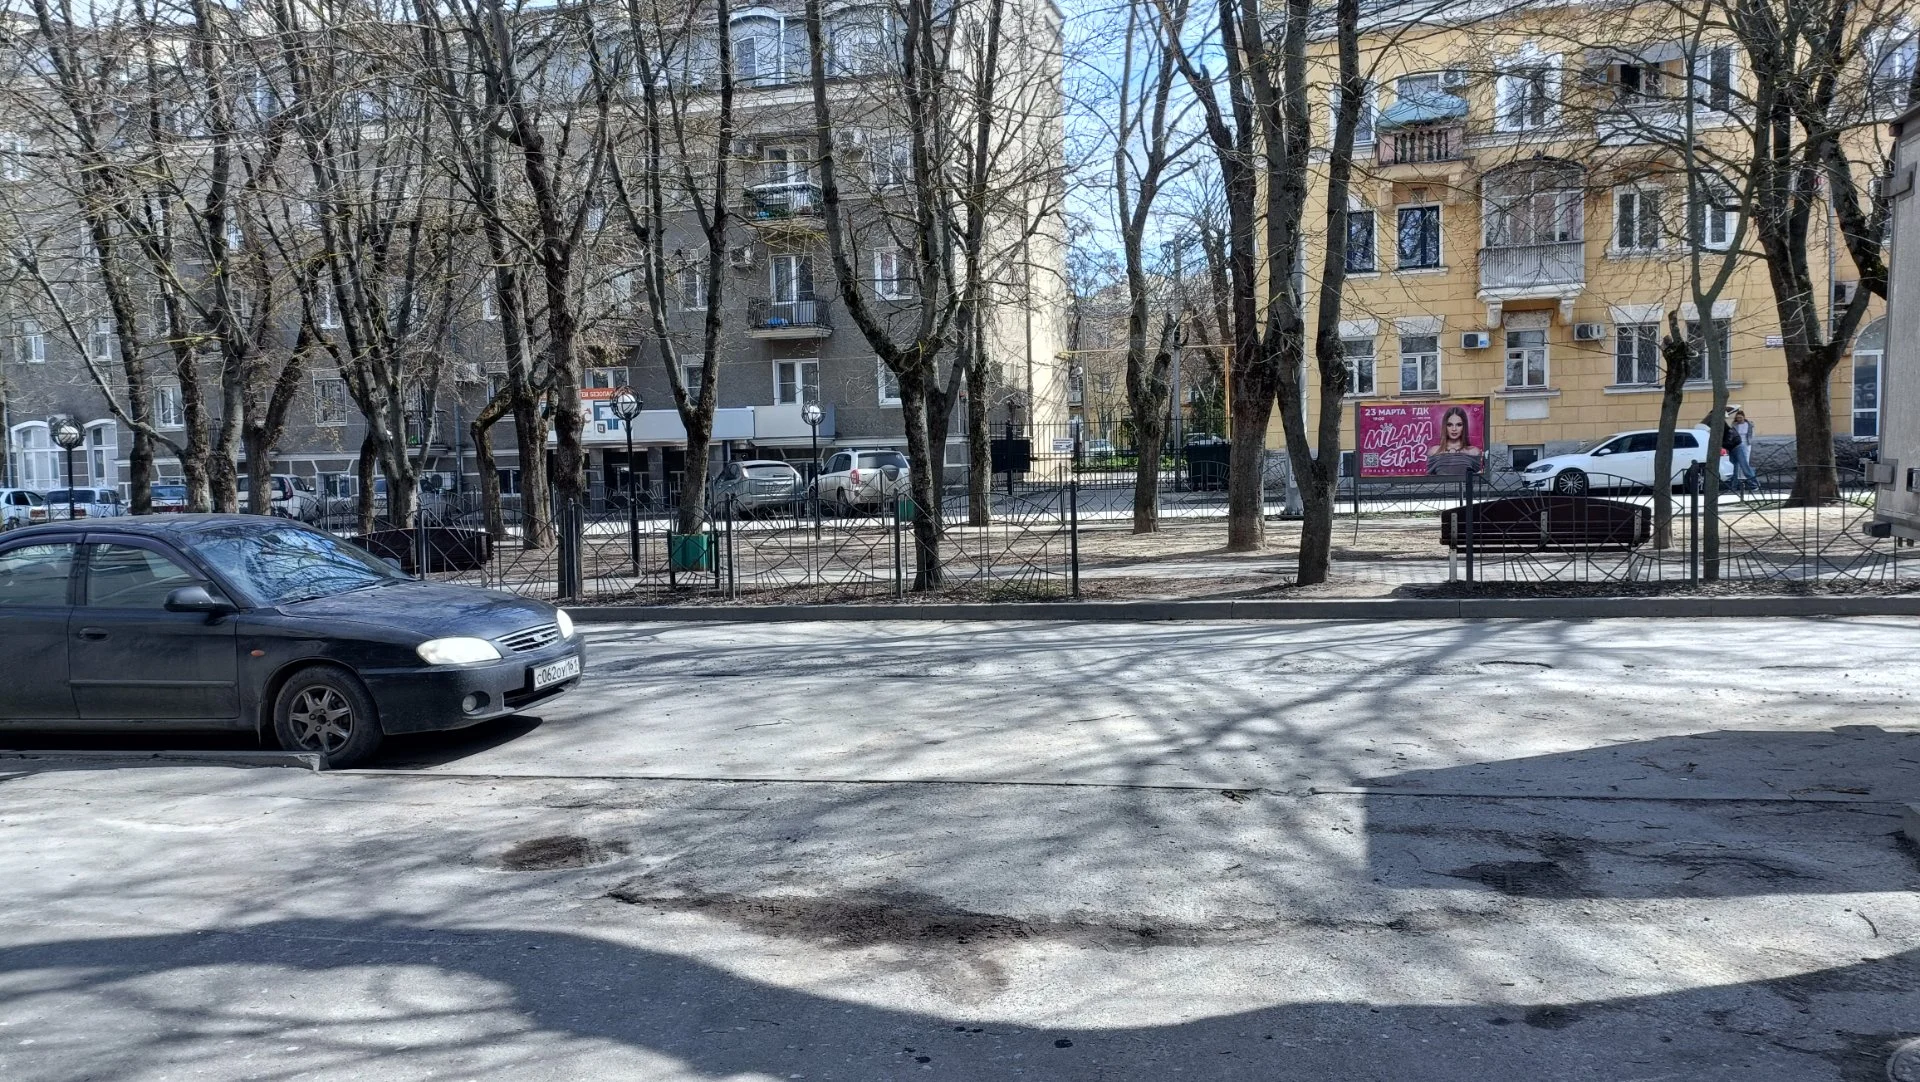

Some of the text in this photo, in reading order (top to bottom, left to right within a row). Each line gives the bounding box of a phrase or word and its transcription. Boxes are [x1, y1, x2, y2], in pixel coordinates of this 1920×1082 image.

[1365, 408, 1407, 416] 23 МАРТА
[1411, 407, 1430, 416] ГДК
[1363, 421, 1433, 449] MILANA
[1379, 444, 1428, 467] STAR
